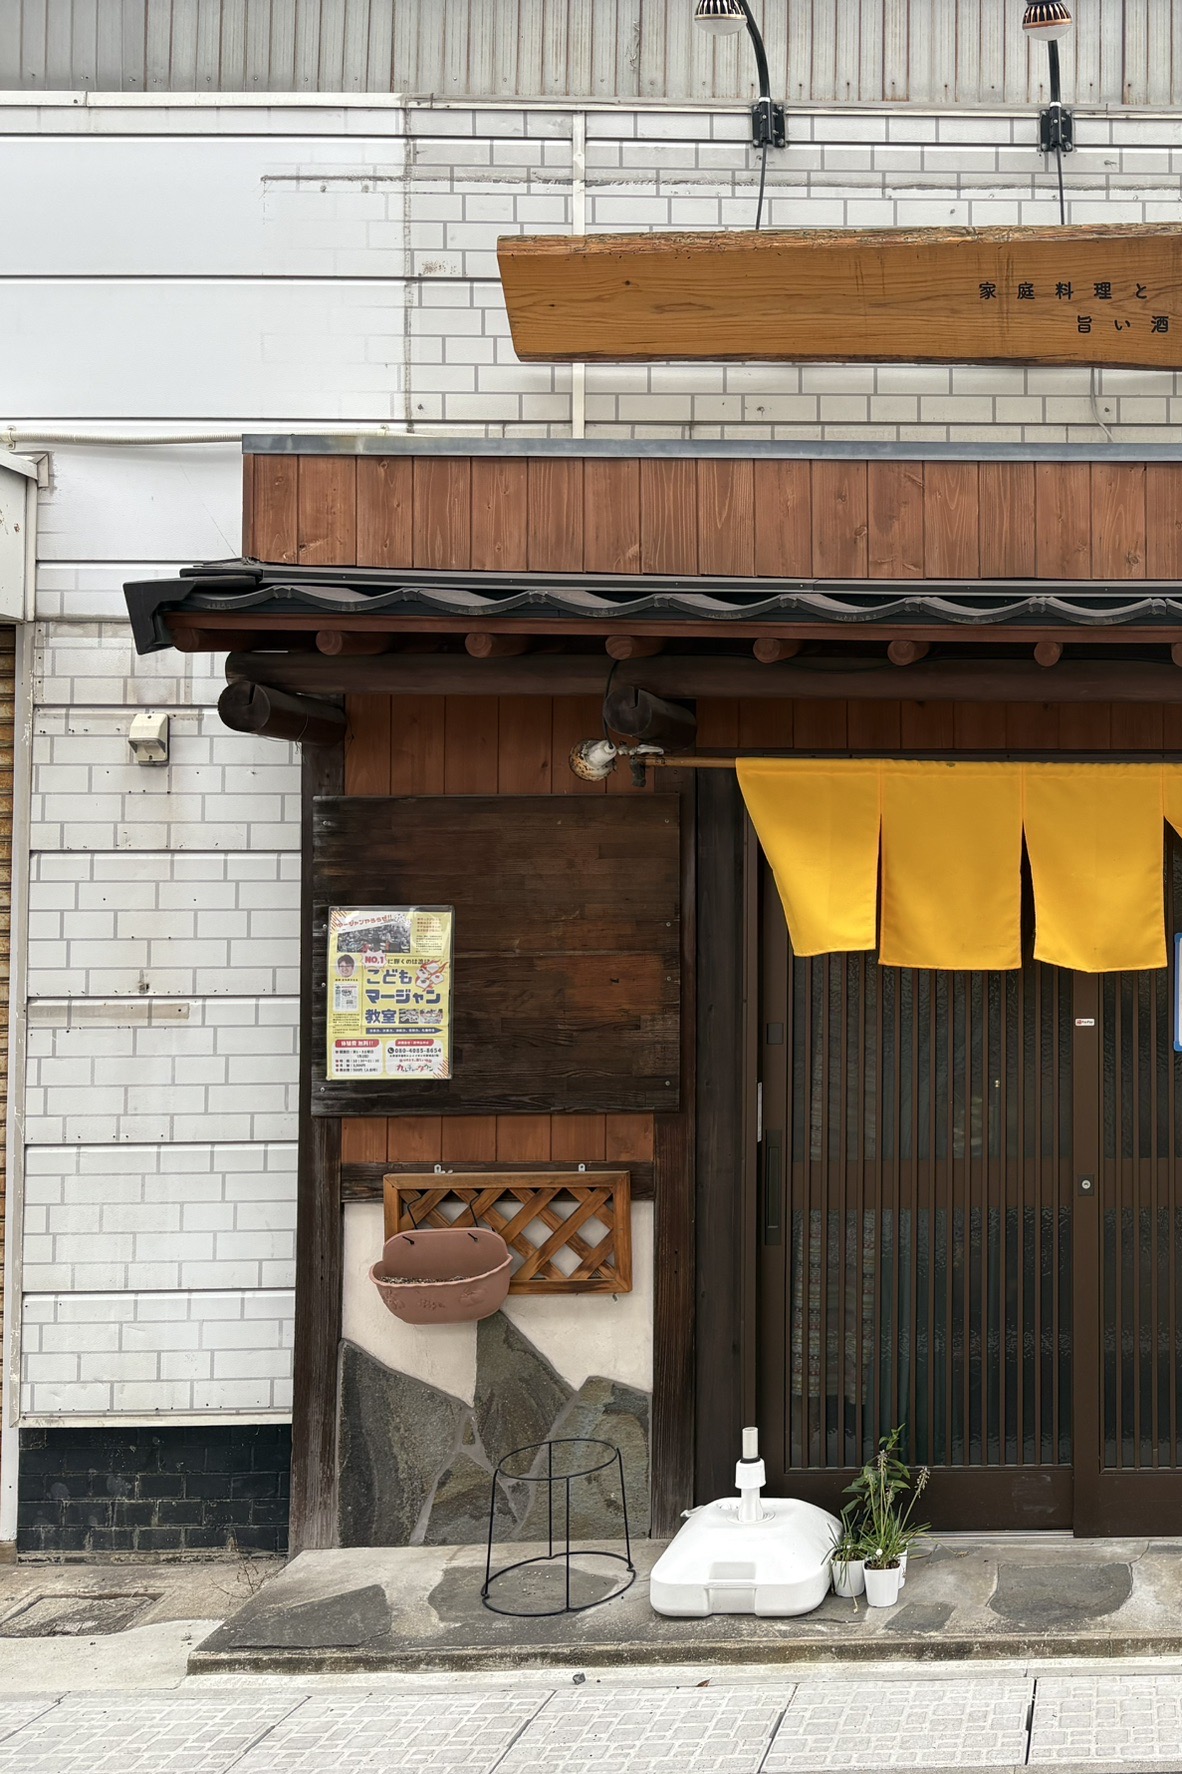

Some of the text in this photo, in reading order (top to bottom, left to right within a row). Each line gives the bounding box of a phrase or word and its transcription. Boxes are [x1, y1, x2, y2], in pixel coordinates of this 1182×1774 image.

[978, 280, 1148, 300] 家庭料理と
[1076, 315, 1170, 334] 旨い酒
[366, 968, 413, 985] こども
[365, 988, 441, 1005] マージャン
[365, 1008, 397, 1025] 教室
